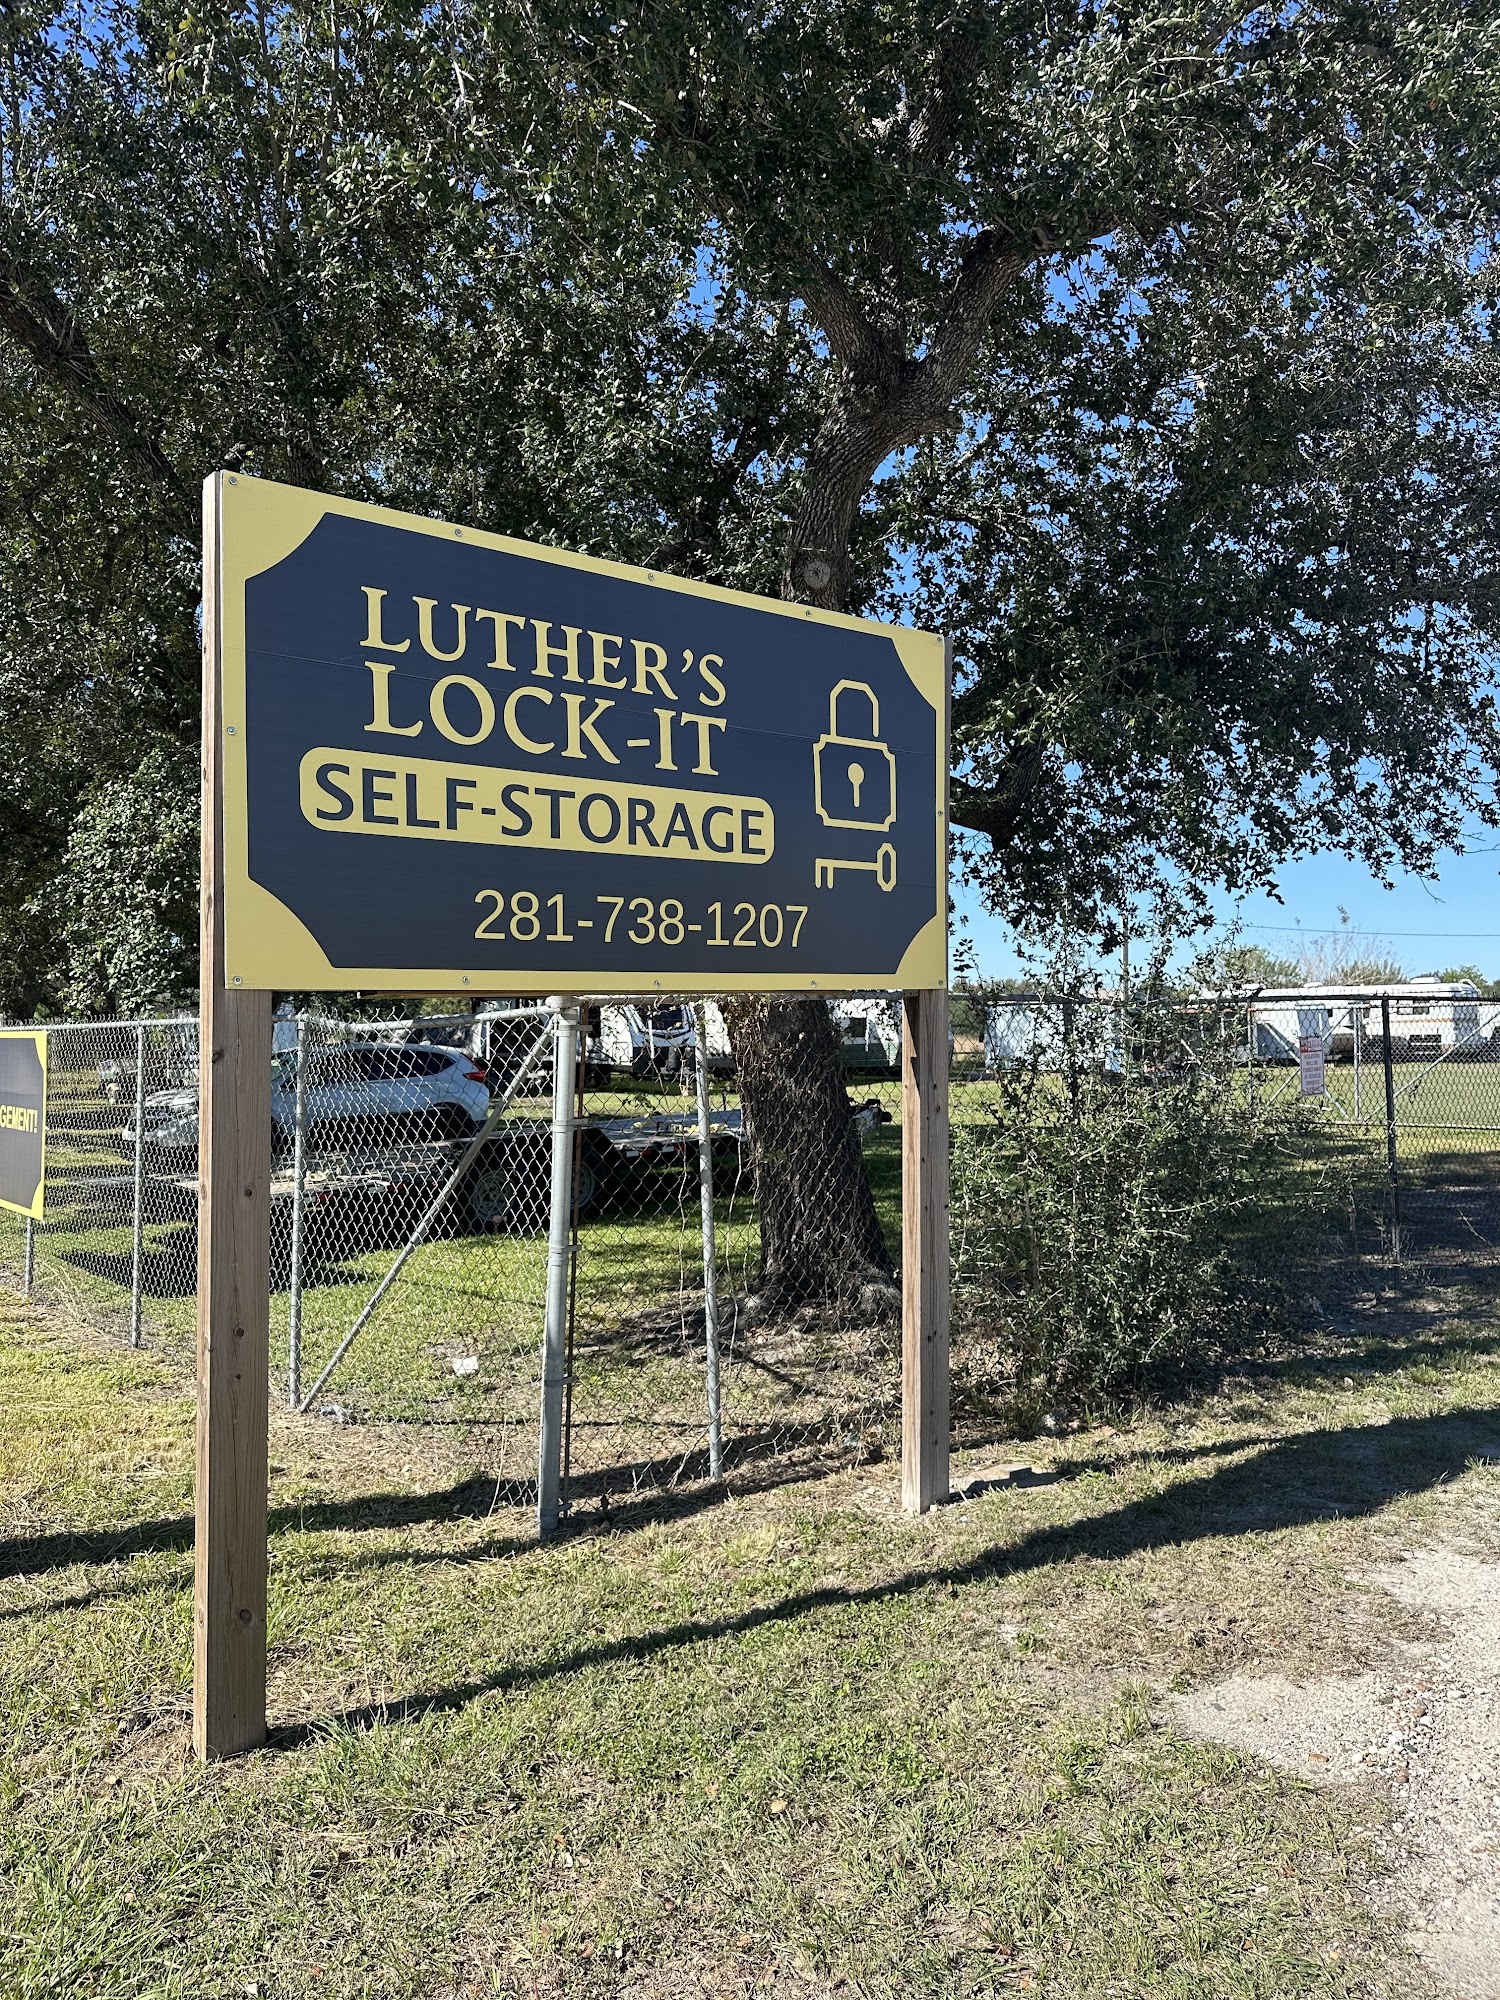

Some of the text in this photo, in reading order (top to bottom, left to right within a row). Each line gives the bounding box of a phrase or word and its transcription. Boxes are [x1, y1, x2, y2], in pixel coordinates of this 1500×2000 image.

[361, 586, 727, 708] LUTHER'S
[364, 661, 728, 775] LOCK-IT
[315, 762, 766, 856] SELF-STORAGE
[474, 889, 808, 948] 281-738-1207
[0, 1104, 38, 1134] GEMENT!
